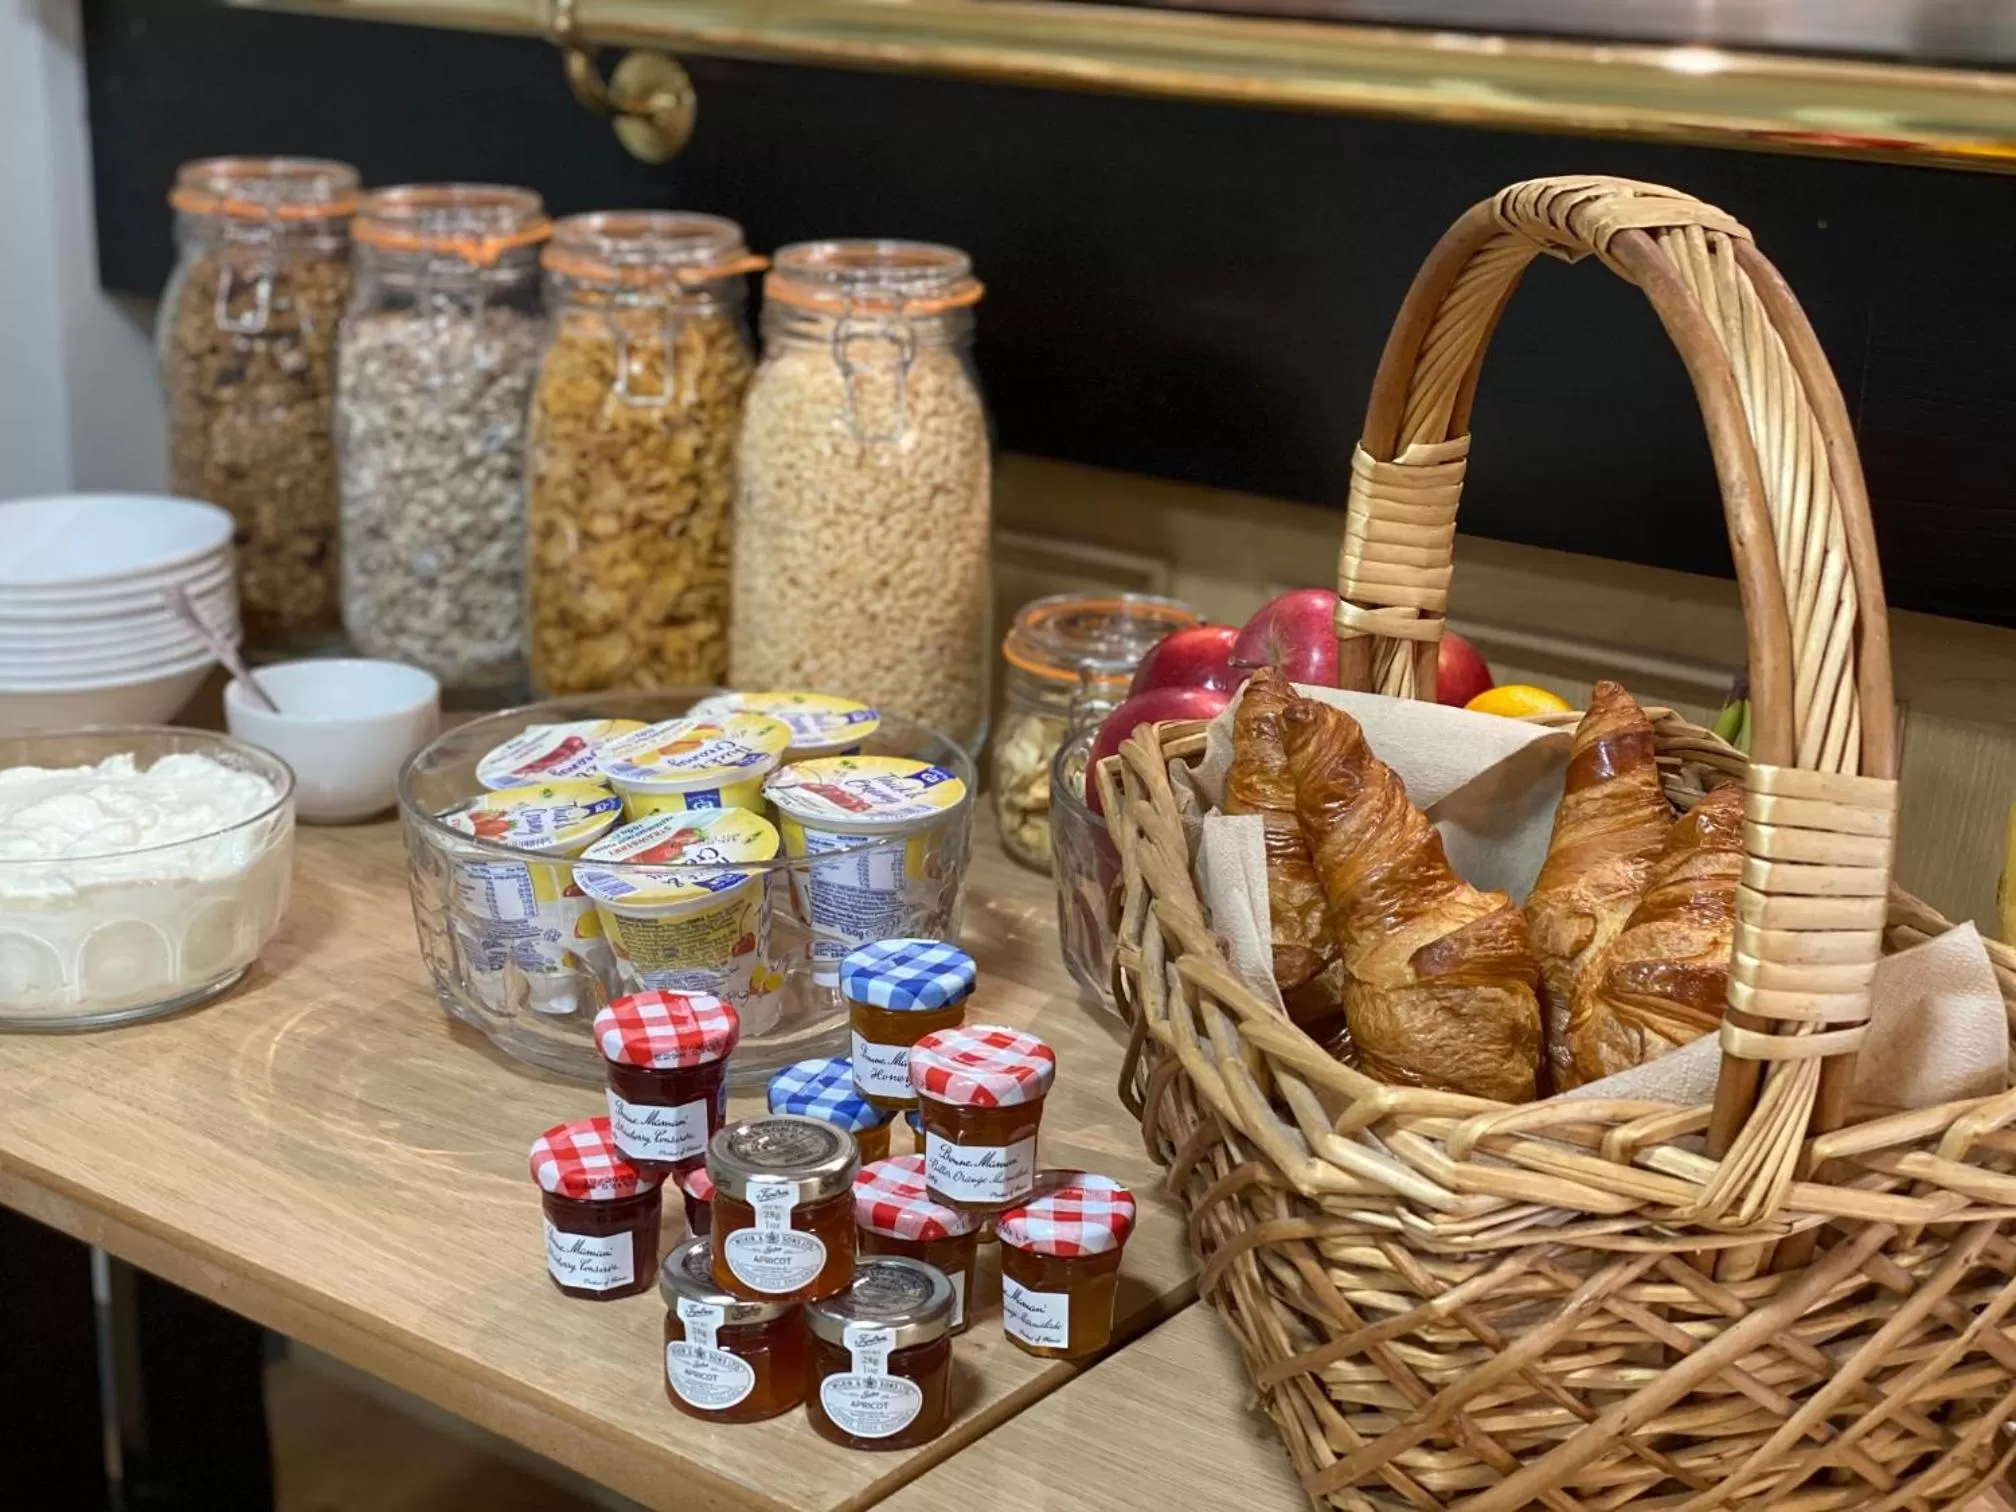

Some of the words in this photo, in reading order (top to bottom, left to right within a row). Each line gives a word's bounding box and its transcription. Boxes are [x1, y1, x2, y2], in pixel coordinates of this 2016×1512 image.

[667, 740, 736, 769] Creamy
[870, 1067, 911, 1088] Honey
[938, 1143, 972, 1168] Bonne
[973, 1150, 1018, 1168] Maman
[753, 1255, 792, 1265] APRICOT
[684, 1368, 718, 1382] APRICOT
[850, 1400, 889, 1410] APRICOT
